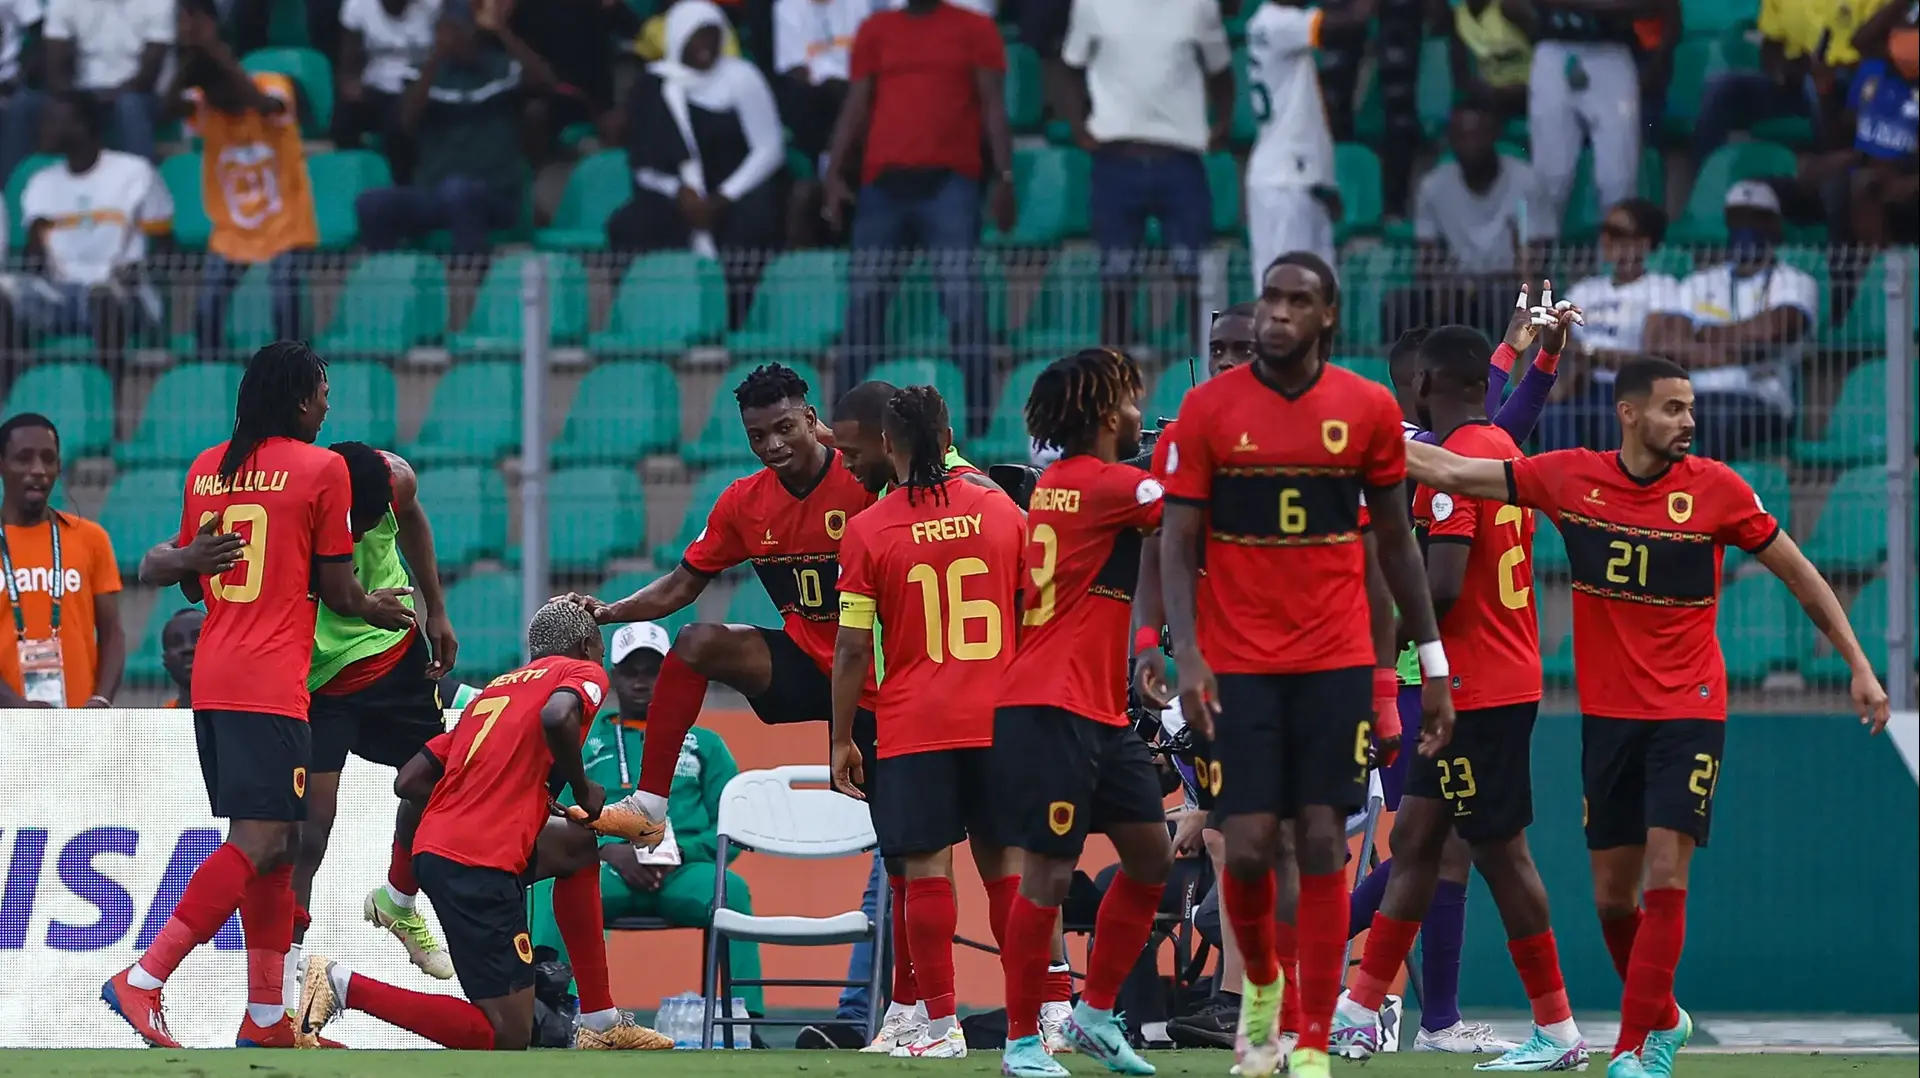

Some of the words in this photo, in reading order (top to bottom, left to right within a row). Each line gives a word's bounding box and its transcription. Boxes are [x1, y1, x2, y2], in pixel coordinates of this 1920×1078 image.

[193, 471, 289, 496] MABLULU
[911, 513, 982, 544] FREDY
[1280, 488, 1307, 534] 6
[1023, 523, 1057, 626] 3
[1606, 540, 1648, 587] 21
[793, 568, 822, 607] 10
[907, 557, 1003, 664] 16
[464, 695, 511, 766] 7
[1437, 757, 1476, 799] 23
[0, 828, 246, 951] ISA
[1185, 881, 1195, 919] DIGITAL
